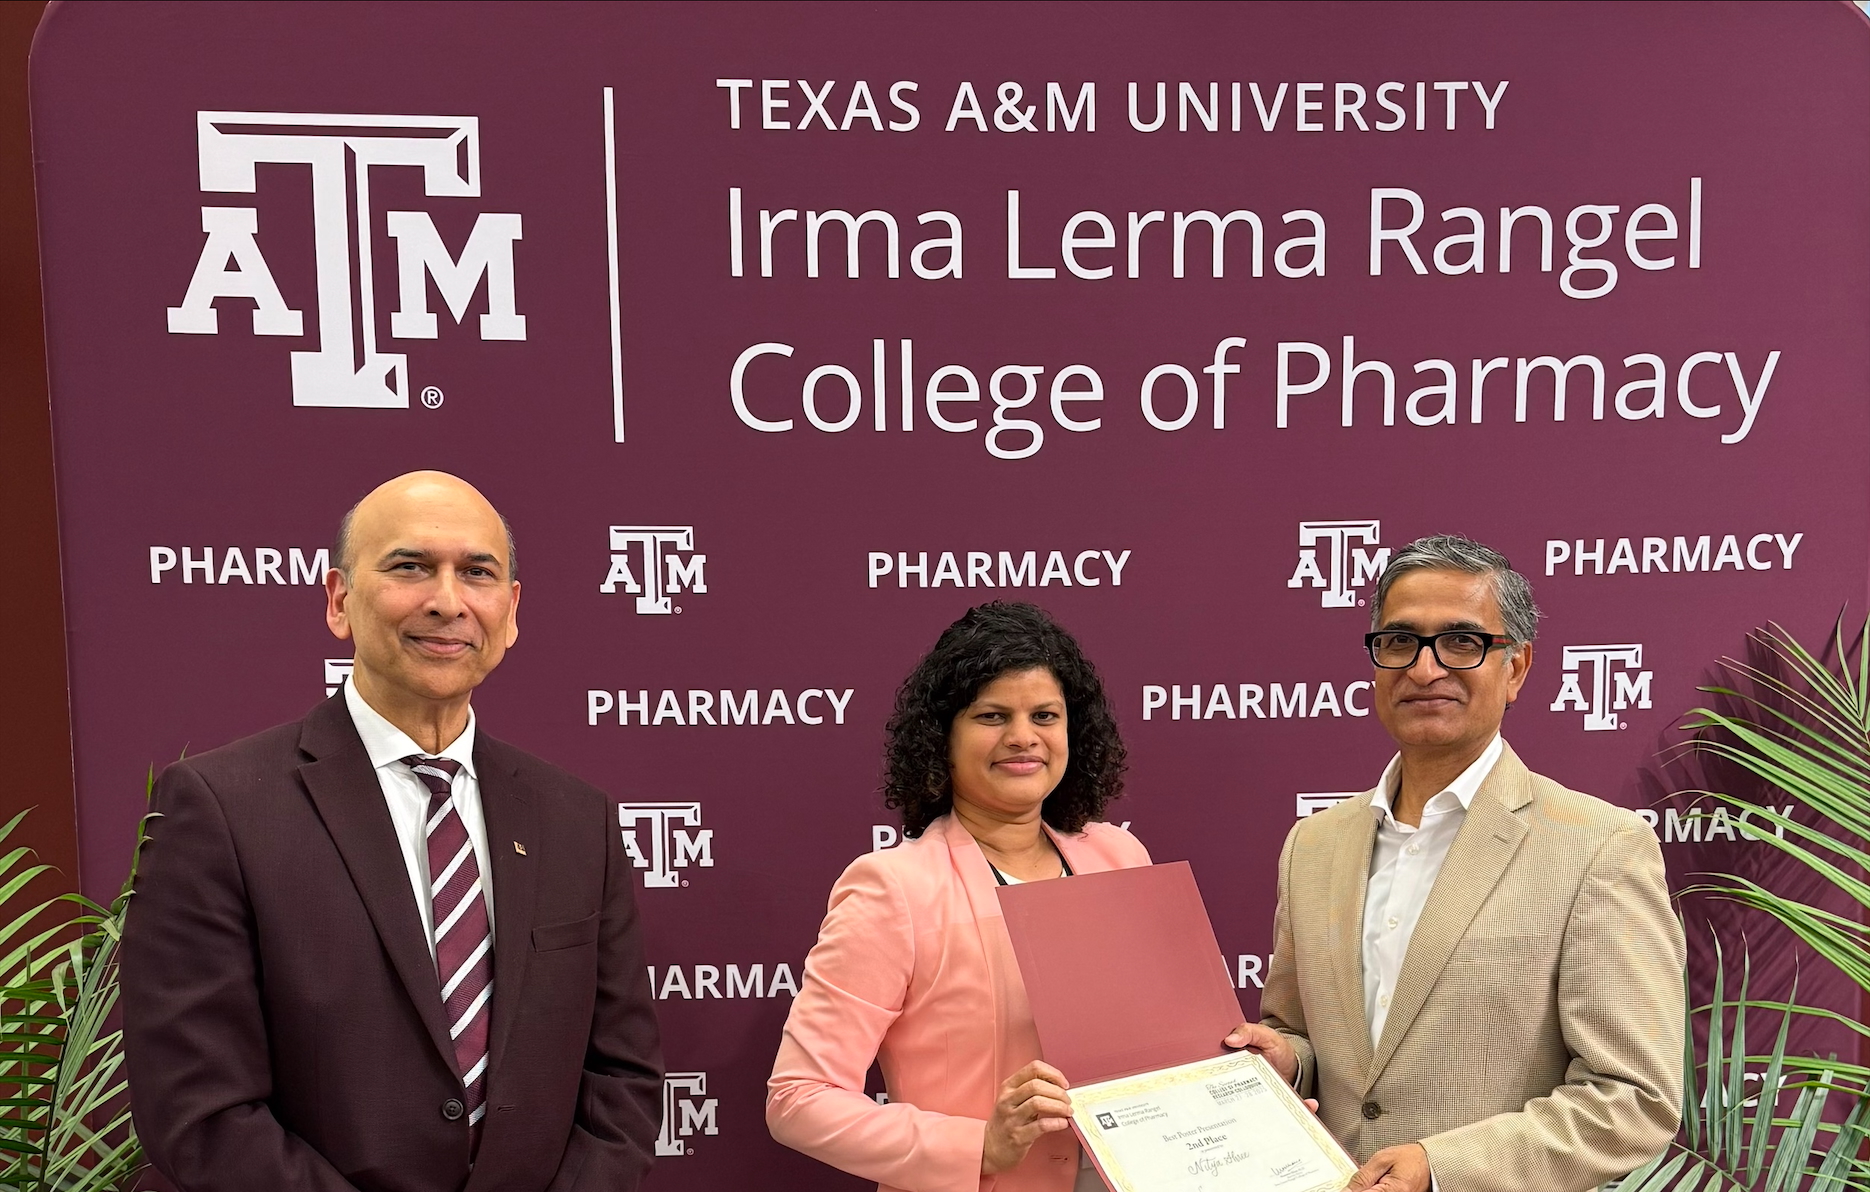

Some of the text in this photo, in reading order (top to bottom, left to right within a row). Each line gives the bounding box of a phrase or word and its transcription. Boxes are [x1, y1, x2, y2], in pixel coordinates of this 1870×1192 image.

[716, 78, 1509, 133] TEXAS A&M UNIVERSITY
[729, 177, 1702, 300] Irma Lerma Rangel
[729, 335, 1781, 460] College of Pharmacy
[868, 550, 1132, 588] PHARMACY
[1545, 532, 1804, 577] PHARMACY
[587, 688, 855, 727] PHARMACY
[1142, 680, 1376, 721] PHARMAC
[1177, 1128, 1197, 1139] Poster
[1197, 1118, 1237, 1133] Presentation
[1186, 1138, 1204, 1151] 2nd
[1203, 1133, 1228, 1146] Place
